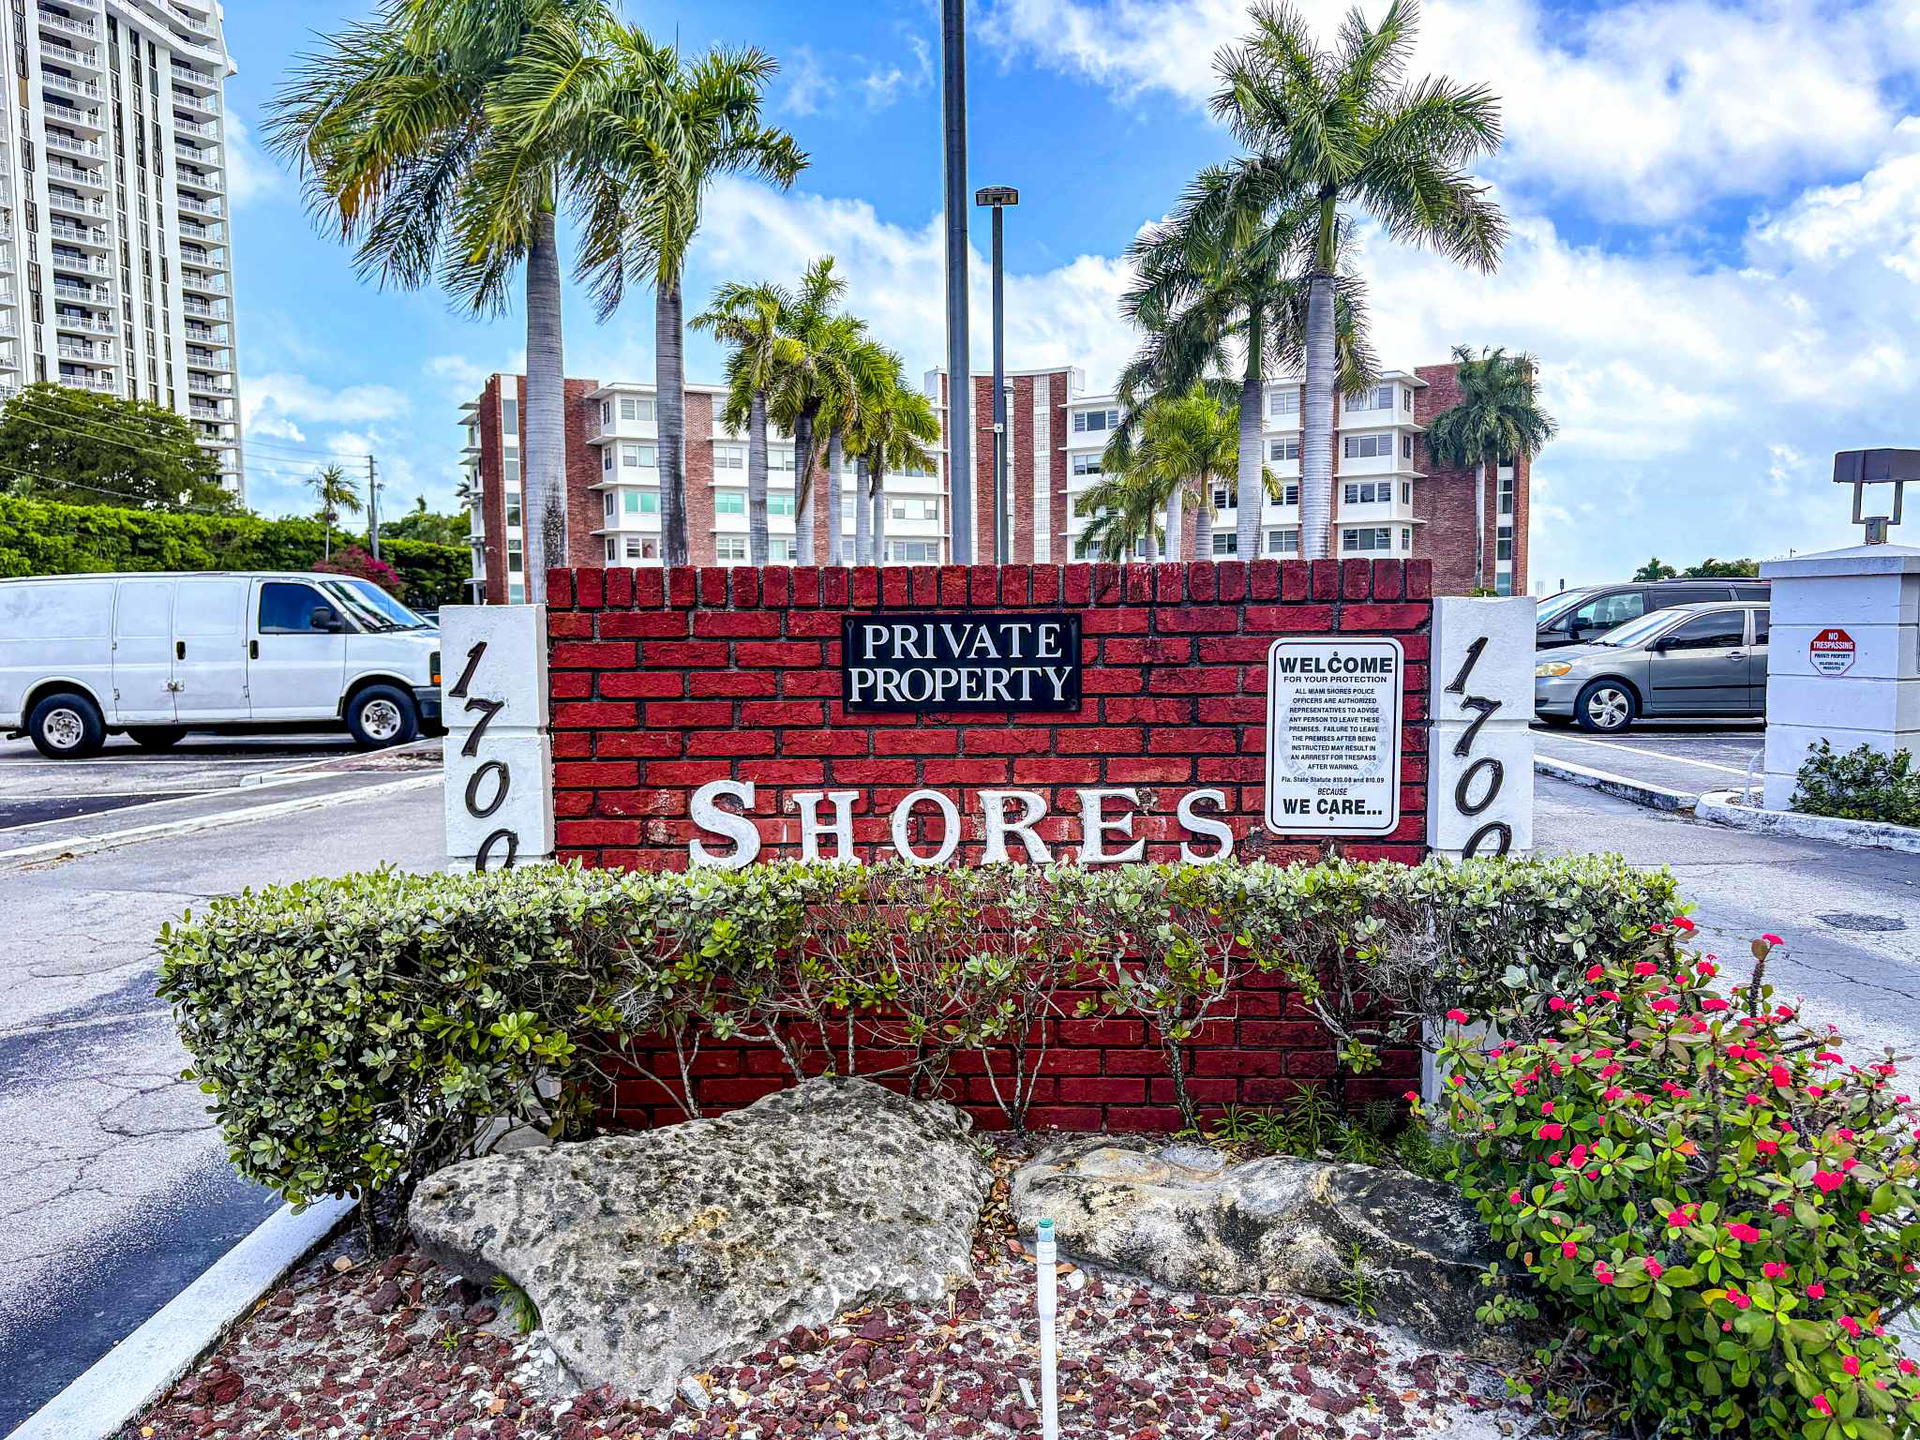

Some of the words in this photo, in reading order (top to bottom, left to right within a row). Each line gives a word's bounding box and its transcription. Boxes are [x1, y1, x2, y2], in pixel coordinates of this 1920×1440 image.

[863, 624, 1062, 659] PRIVATE
[1828, 632, 1838, 640] NO
[1813, 641, 1854, 650] TRESPASSING
[1279, 657, 1392, 673] WELCOME
[848, 666, 1073, 702] PROPERTY
[1283, 799, 1310, 815] WE
[1317, 799, 1382, 815] CARE...
[688, 779, 1235, 869] SHORES
